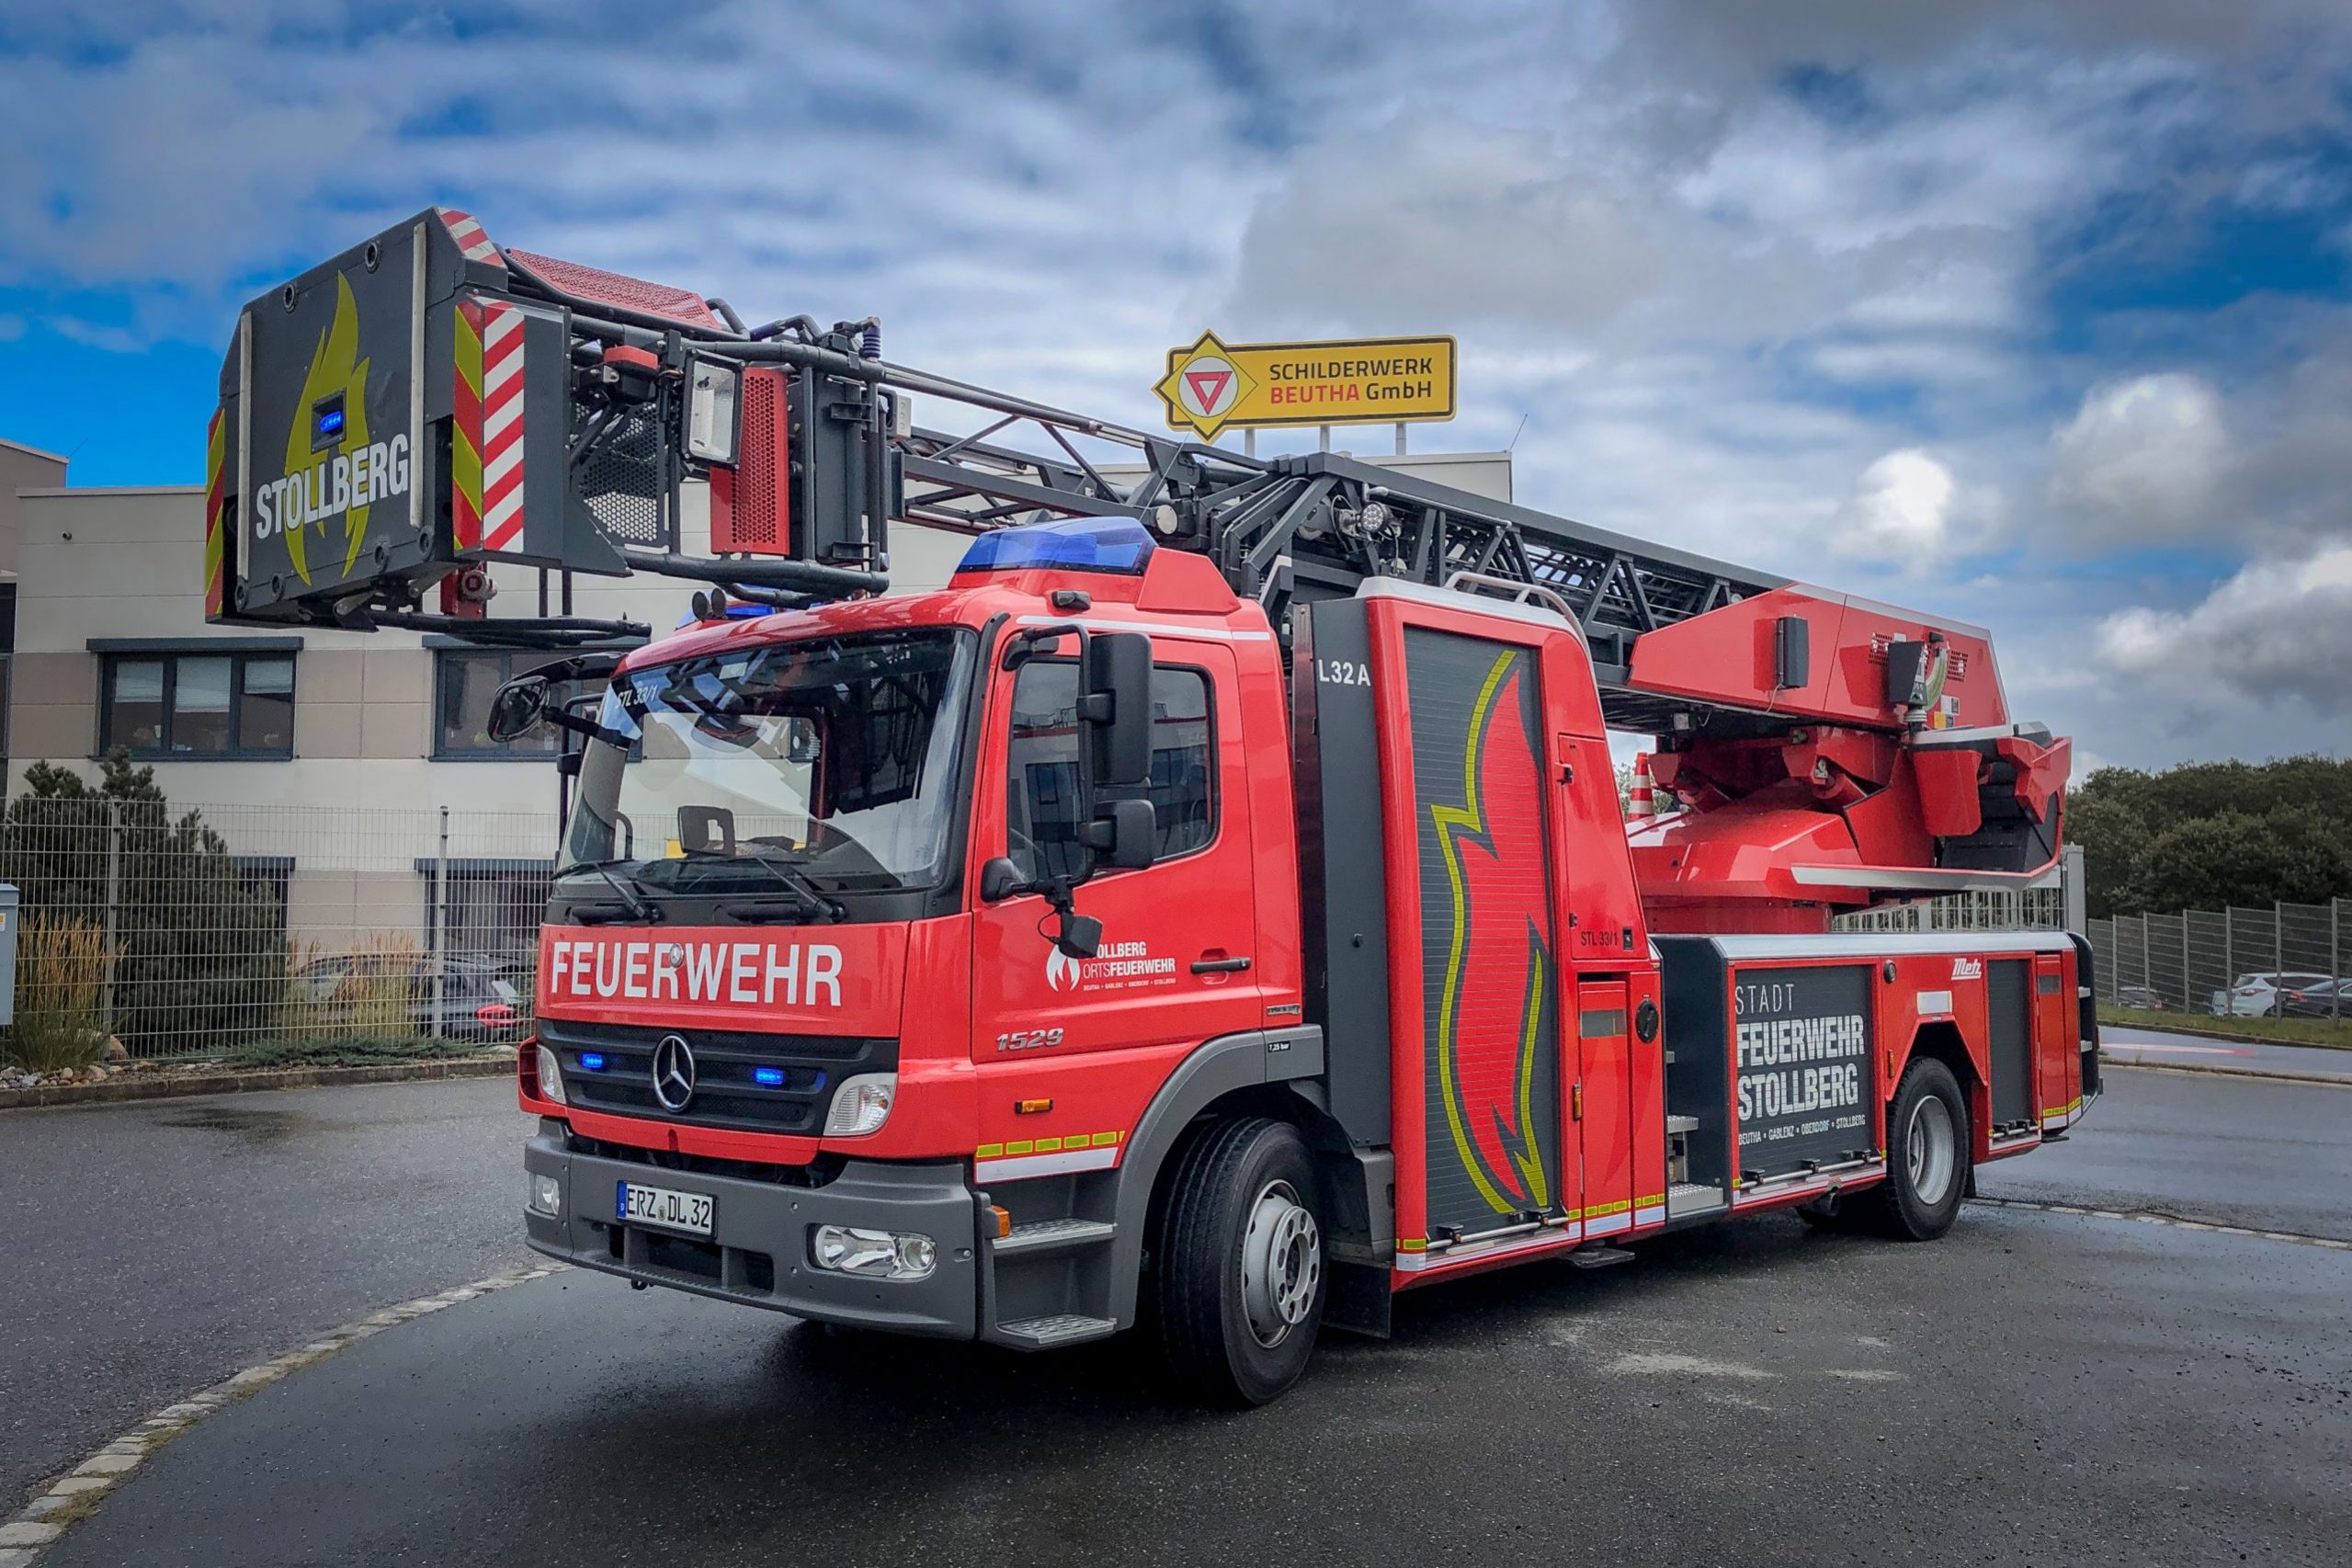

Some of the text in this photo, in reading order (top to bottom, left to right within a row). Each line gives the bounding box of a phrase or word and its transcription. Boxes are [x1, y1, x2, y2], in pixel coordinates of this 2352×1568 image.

[1269, 358, 1432, 381] SCHILDERWERK
[1270, 381, 1432, 404] BEUTHA GmbH
[256, 433, 409, 540] STOLLBERG
[1318, 659, 1371, 687] L32A
[618, 684, 658, 707] STL 33/1
[1085, 941, 1147, 960] OLLBERG
[1581, 930, 1618, 946] STL 33/1
[551, 941, 843, 1006] FEUERWEHR
[1083, 958, 1176, 979] ORTSFEUERWEHR
[1951, 958, 1982, 980] Metz
[1735, 983, 1794, 1015] STADT
[996, 1027, 1064, 1051] 1529
[1736, 1015, 1865, 1068] FEUERWEHR
[1738, 1063, 1858, 1120] STOLLBERG
[1738, 1114, 1866, 1146] BEUTHA GABLENZ OBERDORF STOLLBERG
[627, 1187, 710, 1229] ERZ DL 32
